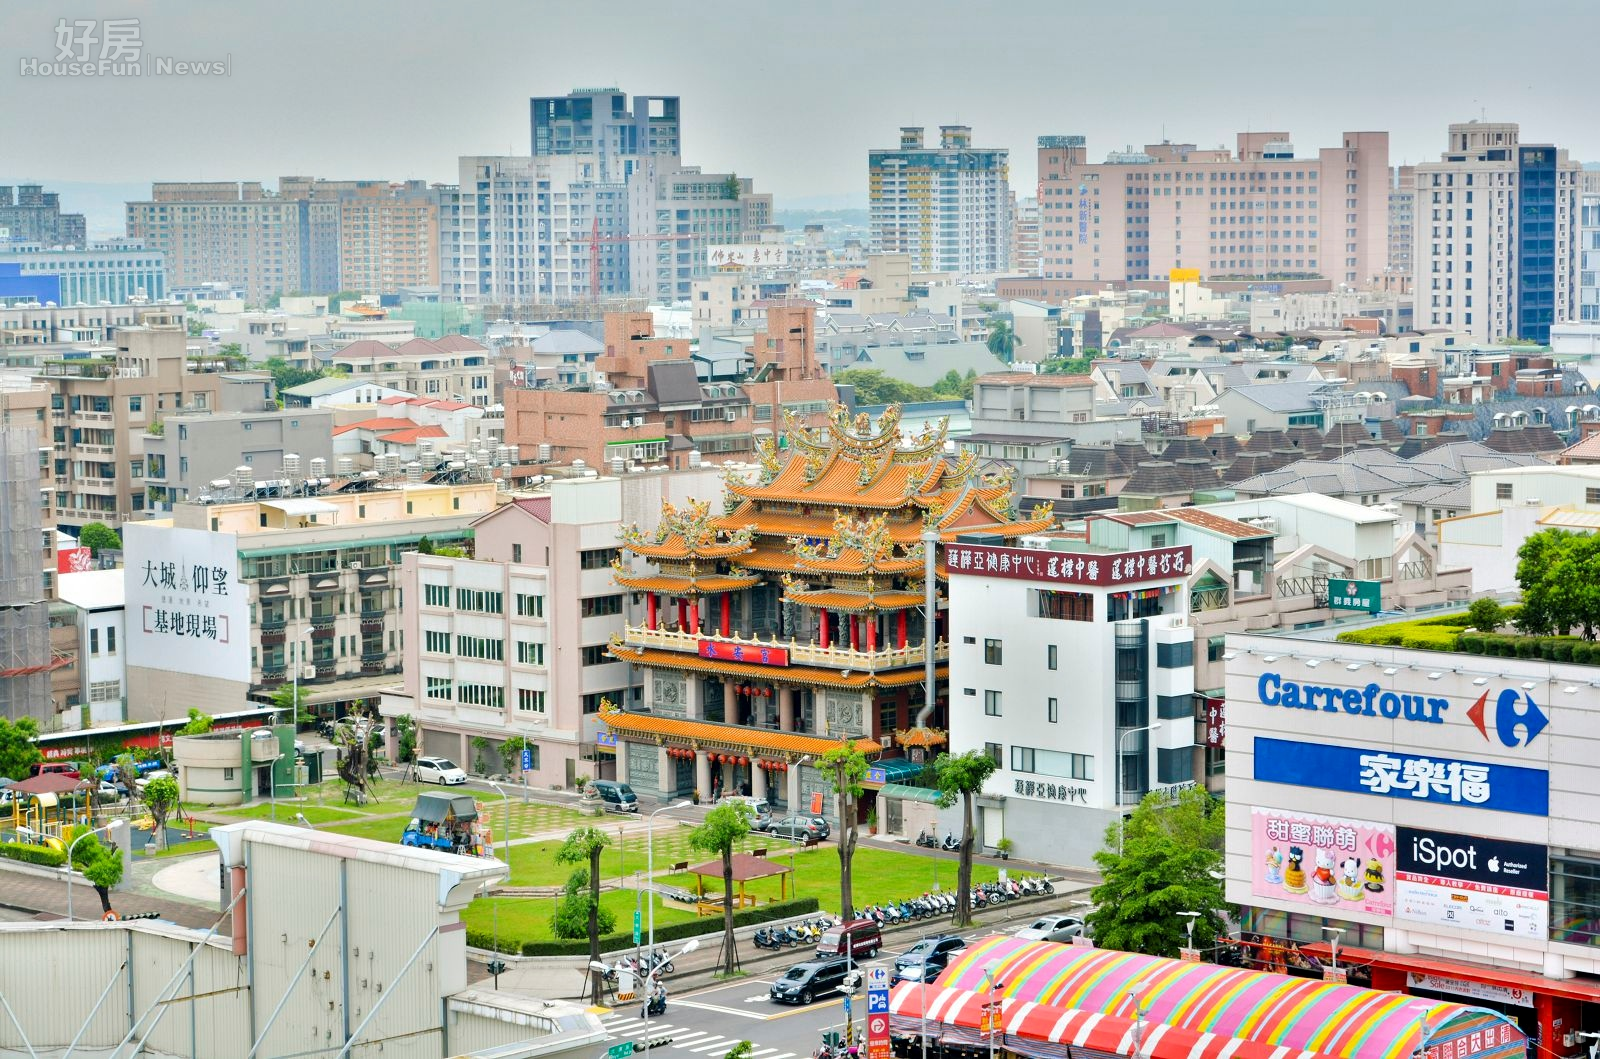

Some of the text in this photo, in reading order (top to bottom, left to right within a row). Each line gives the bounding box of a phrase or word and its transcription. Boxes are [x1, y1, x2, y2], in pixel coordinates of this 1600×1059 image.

[141, 560, 228, 596] 大城 仰望
[155, 609, 217, 640] 基地現場
[1257, 671, 1449, 724] Carrefour
[1360, 753, 1490, 804] 家樂福
[1267, 819, 1358, 852] 甜蜜聯萌
[1413, 836, 1477, 871] iSpot
[1503, 861, 1528, 869] Authorized
[1503, 867, 1520, 875] Reseller
[869, 993, 879, 1011] P
